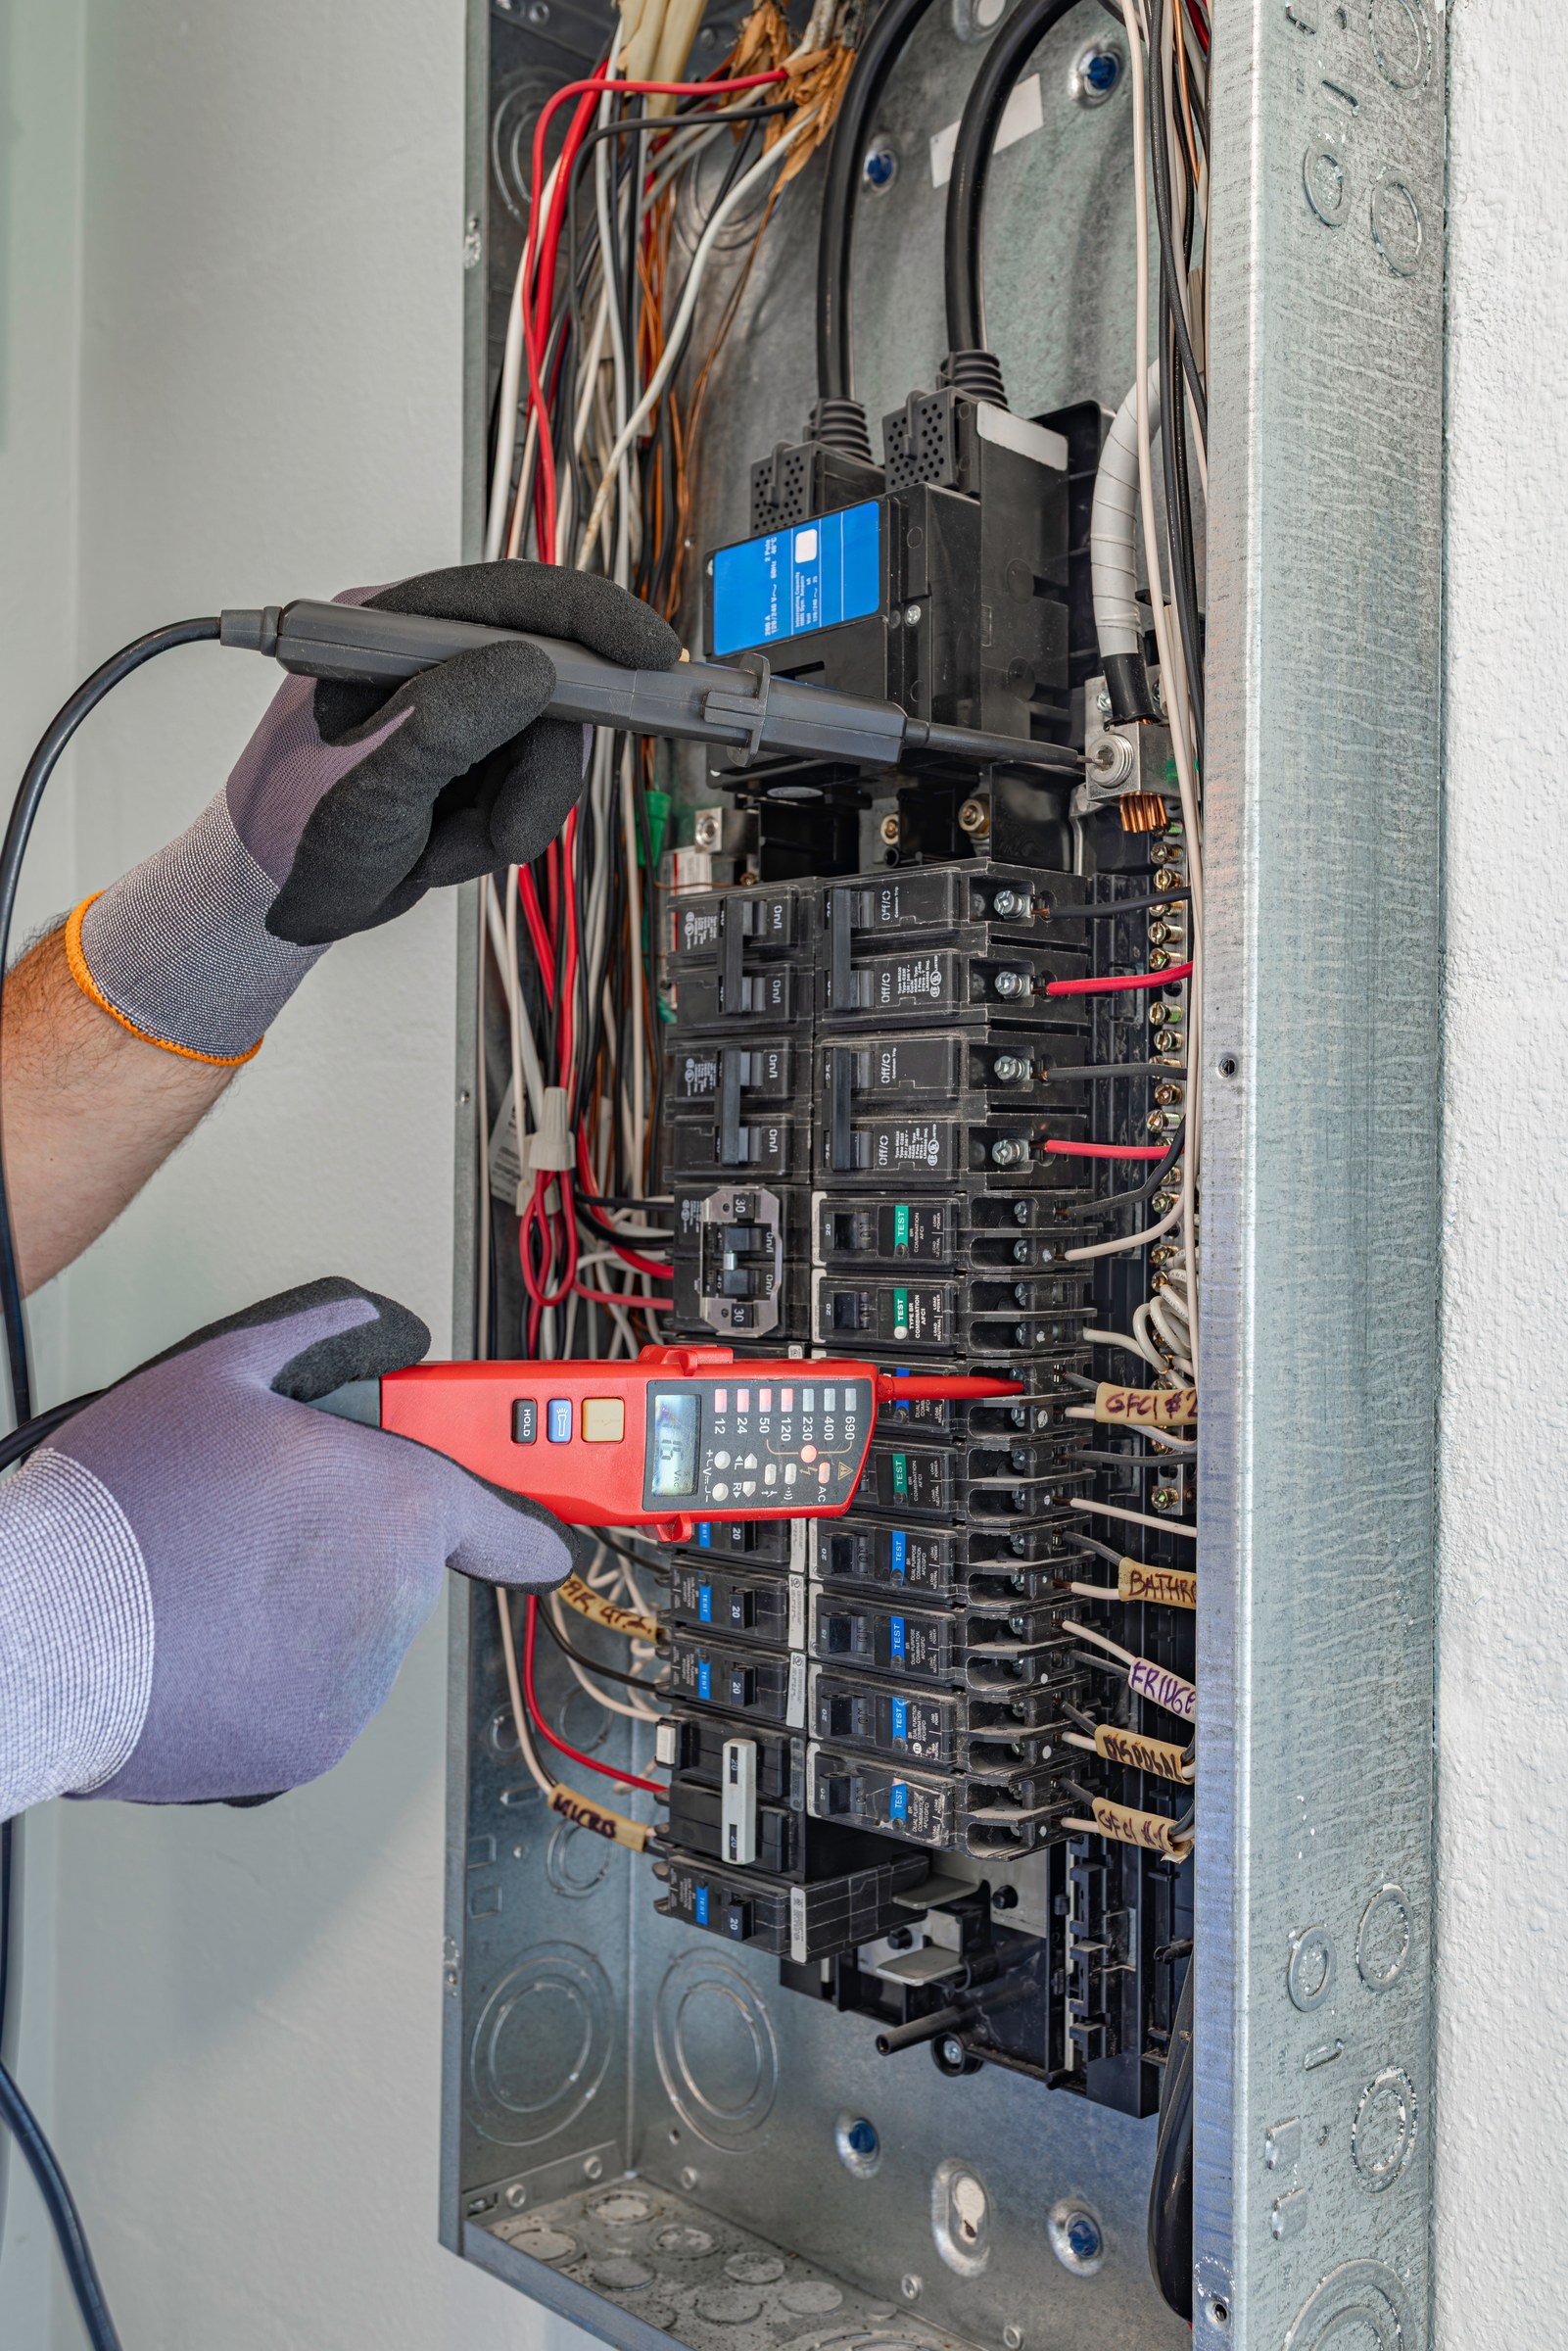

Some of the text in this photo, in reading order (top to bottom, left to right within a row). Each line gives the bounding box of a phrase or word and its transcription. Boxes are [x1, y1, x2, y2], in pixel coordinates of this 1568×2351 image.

[736, 1199, 745, 1213] 30
[734, 1308, 744, 1321] 30
[1105, 1392, 1158, 1421] GFCI
[522, 1409, 532, 1437] HOLD
[714, 1418, 726, 1434] 12
[736, 1417, 748, 1434] 24
[759, 1417, 771, 1434] 50
[781, 1417, 791, 1442] 120
[802, 1416, 814, 1441] 230
[824, 1415, 834, 1441] 400
[844, 1415, 856, 1441] 690
[817, 1486, 828, 1503] AC
[733, 1527, 741, 1540] 20
[732, 1606, 740, 1618] 20
[733, 1682, 740, 1695] 20
[822, 1708, 828, 1722] 20
[1103, 1736, 1183, 1782] DISPOSAL
[820, 1788, 826, 1799] 20
[729, 1918, 738, 1931] 20
